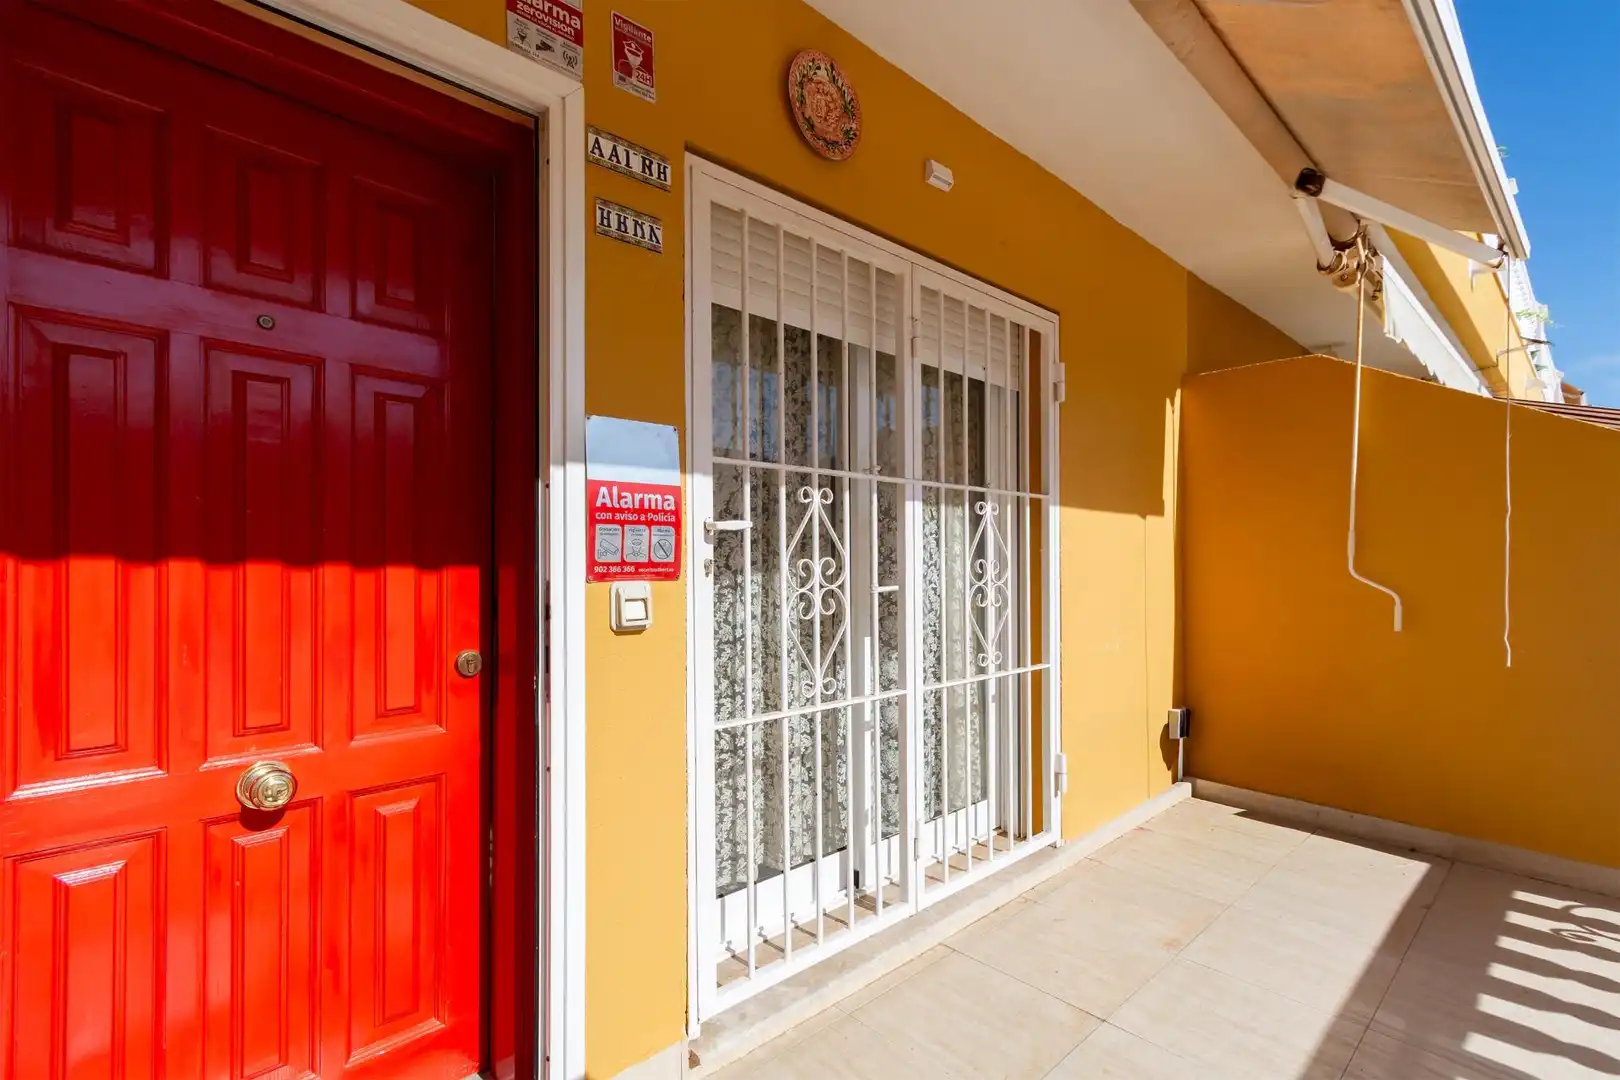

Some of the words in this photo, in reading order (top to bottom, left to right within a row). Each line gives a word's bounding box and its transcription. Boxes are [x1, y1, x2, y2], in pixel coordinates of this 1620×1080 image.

[516, 1, 575, 36] zerovision
[614, 15, 652, 42] Vigilante
[635, 71, 652, 85] 24H
[595, 485, 676, 511] Alarma
[595, 512, 612, 520] con
[614, 511, 638, 521] aviso
[648, 512, 676, 522] Policía
